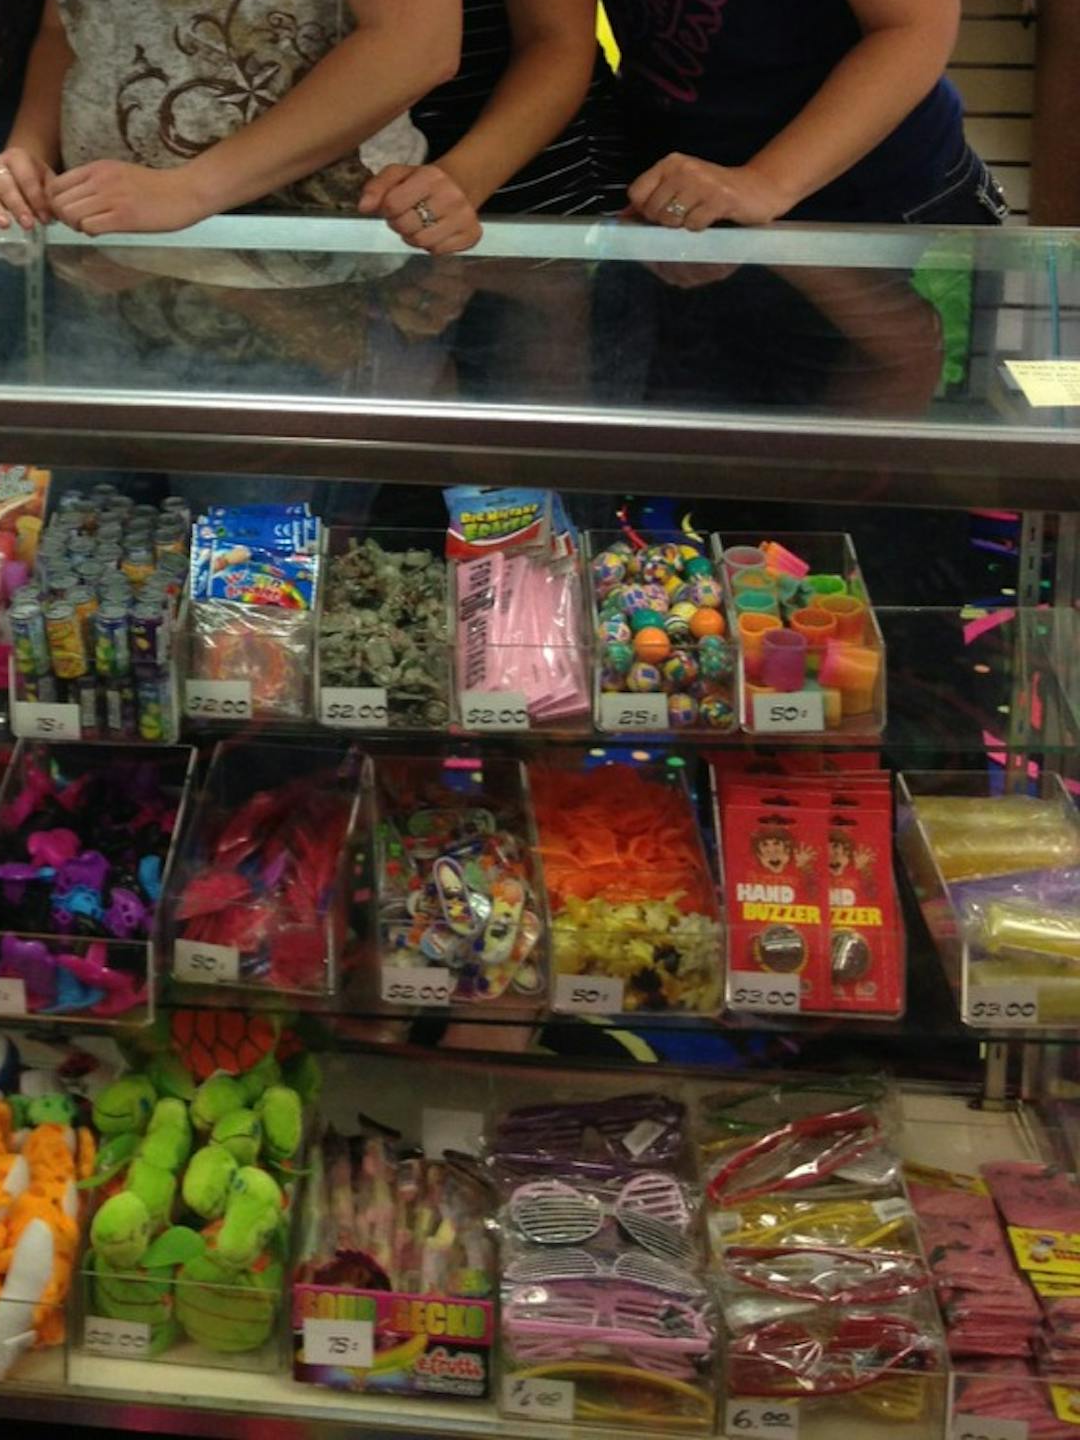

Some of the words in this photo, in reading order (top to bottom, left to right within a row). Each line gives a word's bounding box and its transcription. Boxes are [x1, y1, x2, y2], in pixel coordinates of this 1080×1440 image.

[736, 882, 795, 904] HAND
[742, 901, 821, 926] BUZZER
[830, 905, 883, 928] ZZER
[299, 1291, 377, 1322] SOUR
[391, 1298, 486, 1339] GECKO
